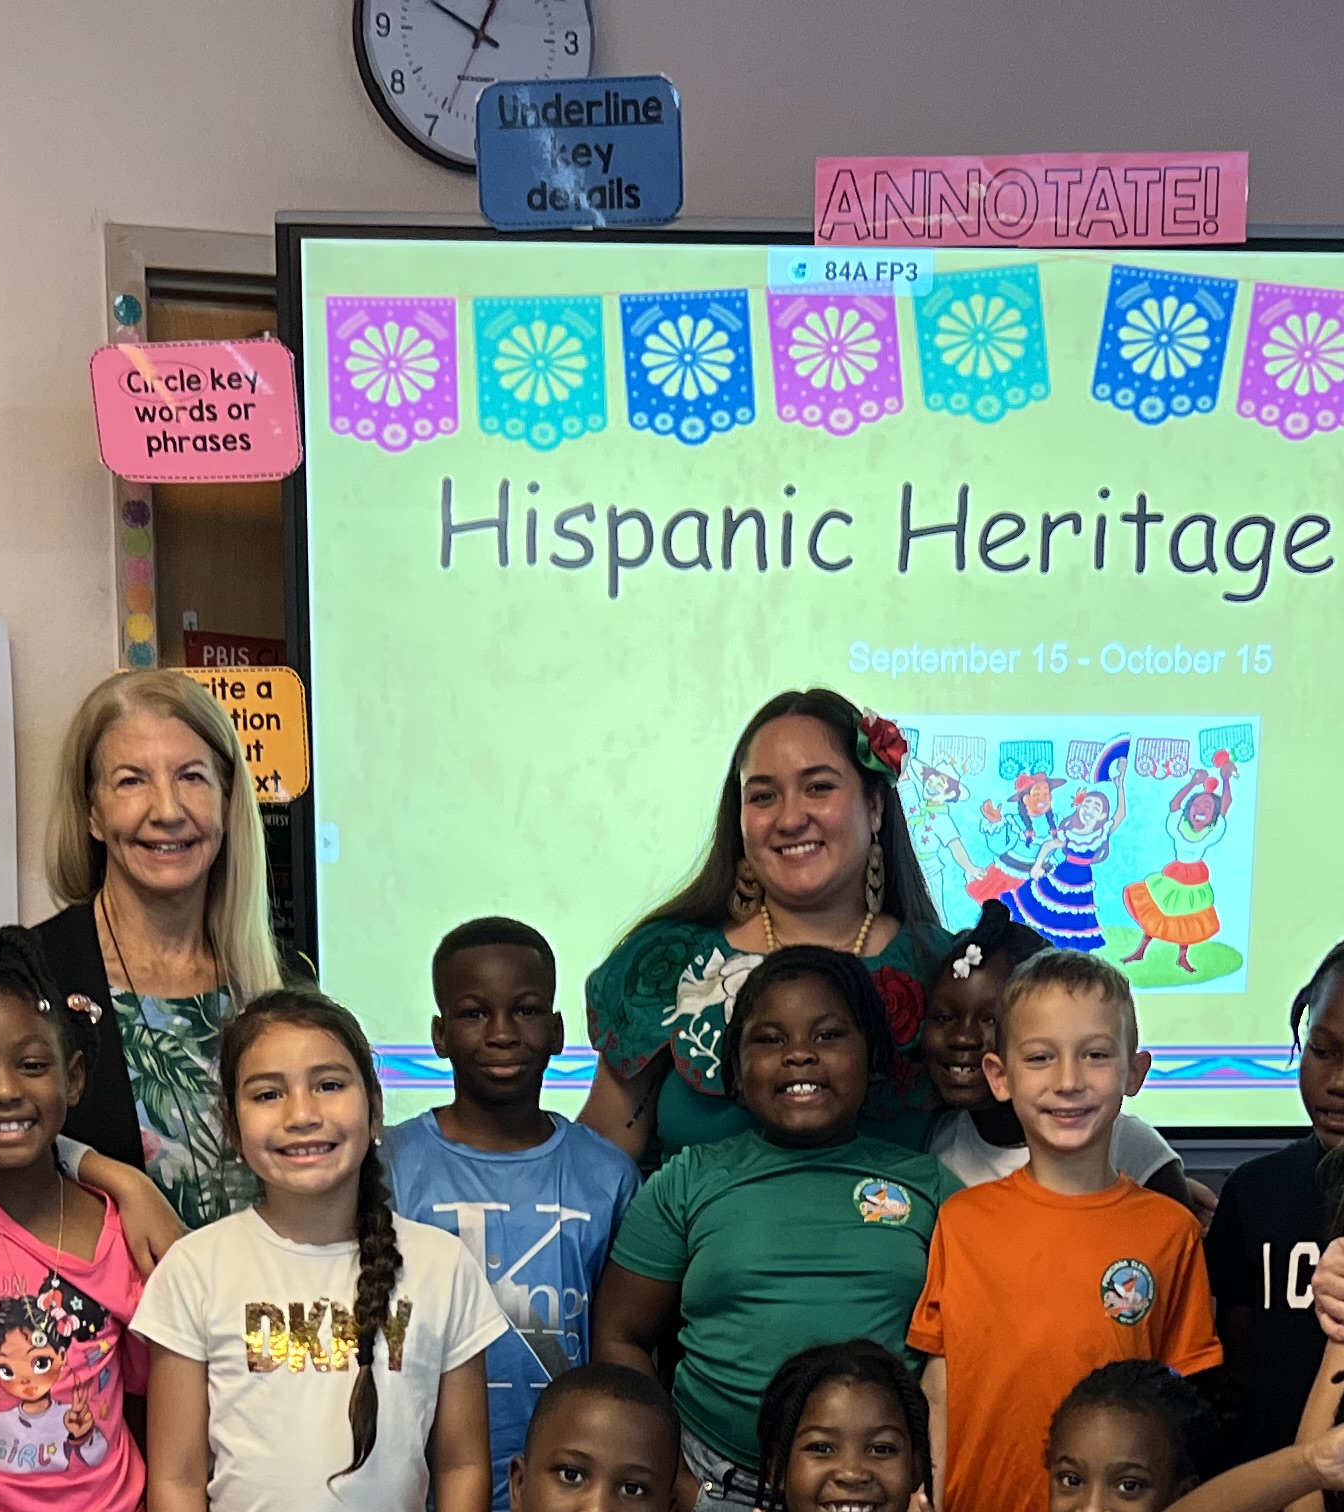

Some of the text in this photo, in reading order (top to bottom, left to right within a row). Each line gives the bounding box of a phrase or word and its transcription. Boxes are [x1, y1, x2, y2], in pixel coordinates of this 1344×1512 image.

[376, 12, 391, 37] 9
[564, 30, 579, 55] 3
[391, 70, 405, 94] 8
[498, 90, 664, 128] Underline
[425, 113, 439, 137] 7
[818, 166, 1221, 240] ANNOTATE!
[824, 261, 919, 283] 84A FP3
[210, 367, 258, 394] key
[135, 399, 256, 424] words or
[146, 431, 252, 458] phrases
[439, 477, 853, 600] Hispanic
[898, 482, 1336, 602] Heritage
[203, 645, 249, 666] PBIS
[848, 641, 1021, 680] September
[1032, 642, 1069, 674] 15
[1101, 643, 1225, 674] October
[1236, 643, 1273, 675] 15
[256, 681, 272, 699] a
